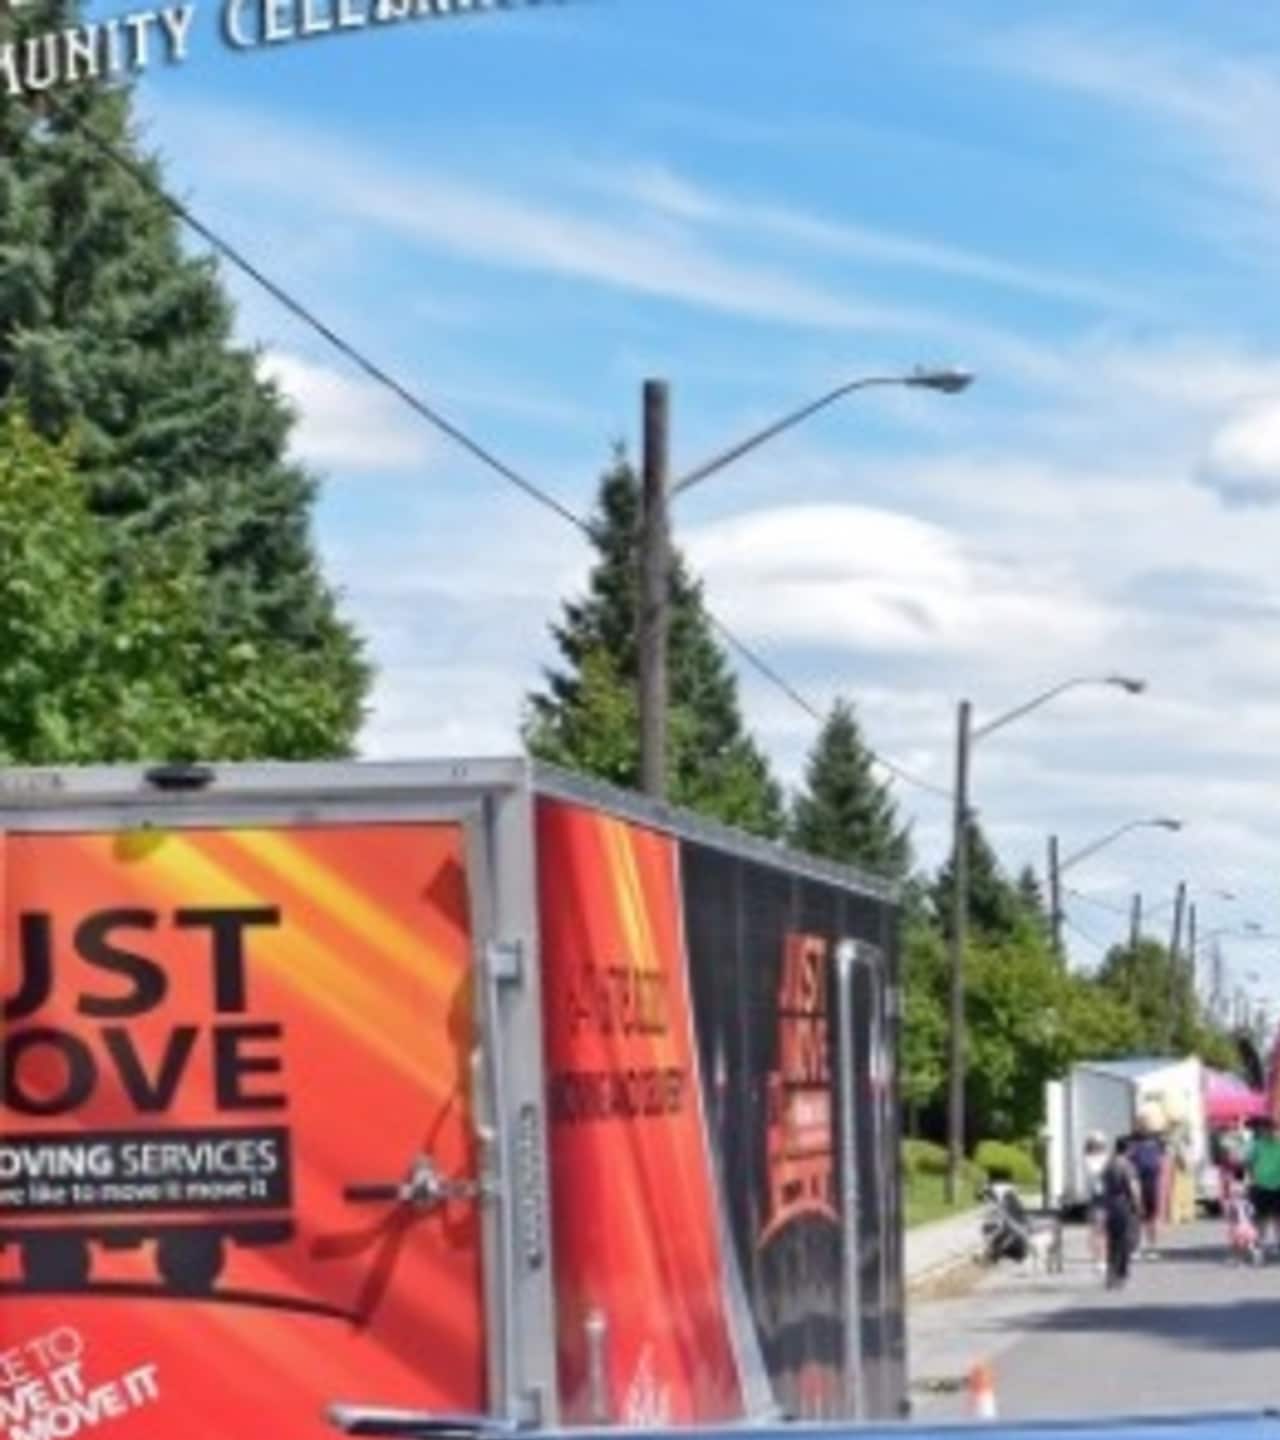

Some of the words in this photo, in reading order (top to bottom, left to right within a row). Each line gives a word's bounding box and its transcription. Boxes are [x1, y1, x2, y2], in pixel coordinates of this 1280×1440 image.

[121, 1140, 277, 1173] SERVICES
[101, 1182, 160, 1201] move
[185, 1181, 247, 1200] move
[250, 1177, 268, 1198] it
[24, 1325, 85, 1369] TO
[0, 1379, 49, 1430] VE
[49, 1361, 85, 1402] IT
[121, 1363, 160, 1408] IT
